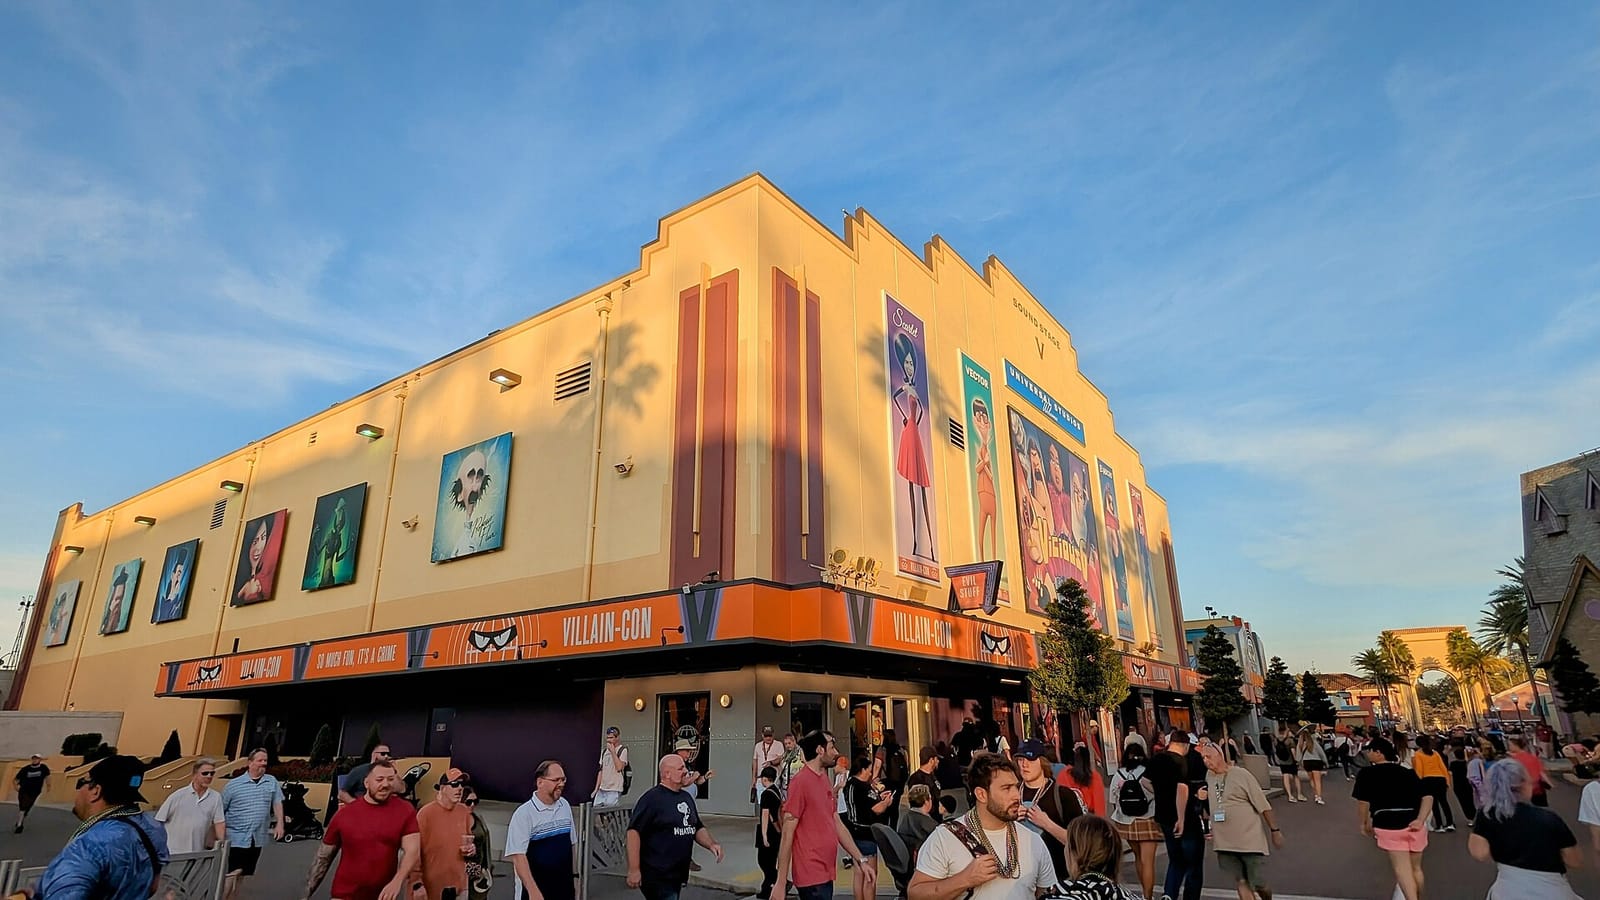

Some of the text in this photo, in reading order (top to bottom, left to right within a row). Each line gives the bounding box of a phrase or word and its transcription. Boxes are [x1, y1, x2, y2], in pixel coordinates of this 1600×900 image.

[1012, 297, 1039, 327] SOUND
[1034, 335, 1045, 360] V
[965, 364, 990, 390] VECTOR
[1008, 366, 1052, 405] UNIVERSAL
[1053, 403, 1082, 431] STUDIOS
[959, 586, 980, 599] STUFF
[961, 574, 977, 587] EVIL
[563, 606, 652, 647] VILLAIN-CON
[893, 610, 953, 650] VILLAIN-CON
[240, 656, 282, 680] VILLAIN-CON
[316, 653, 324, 669] SO
[325, 651, 341, 668] MUCH
[369, 647, 375, 664] A
[377, 644, 397, 663] CRIME
